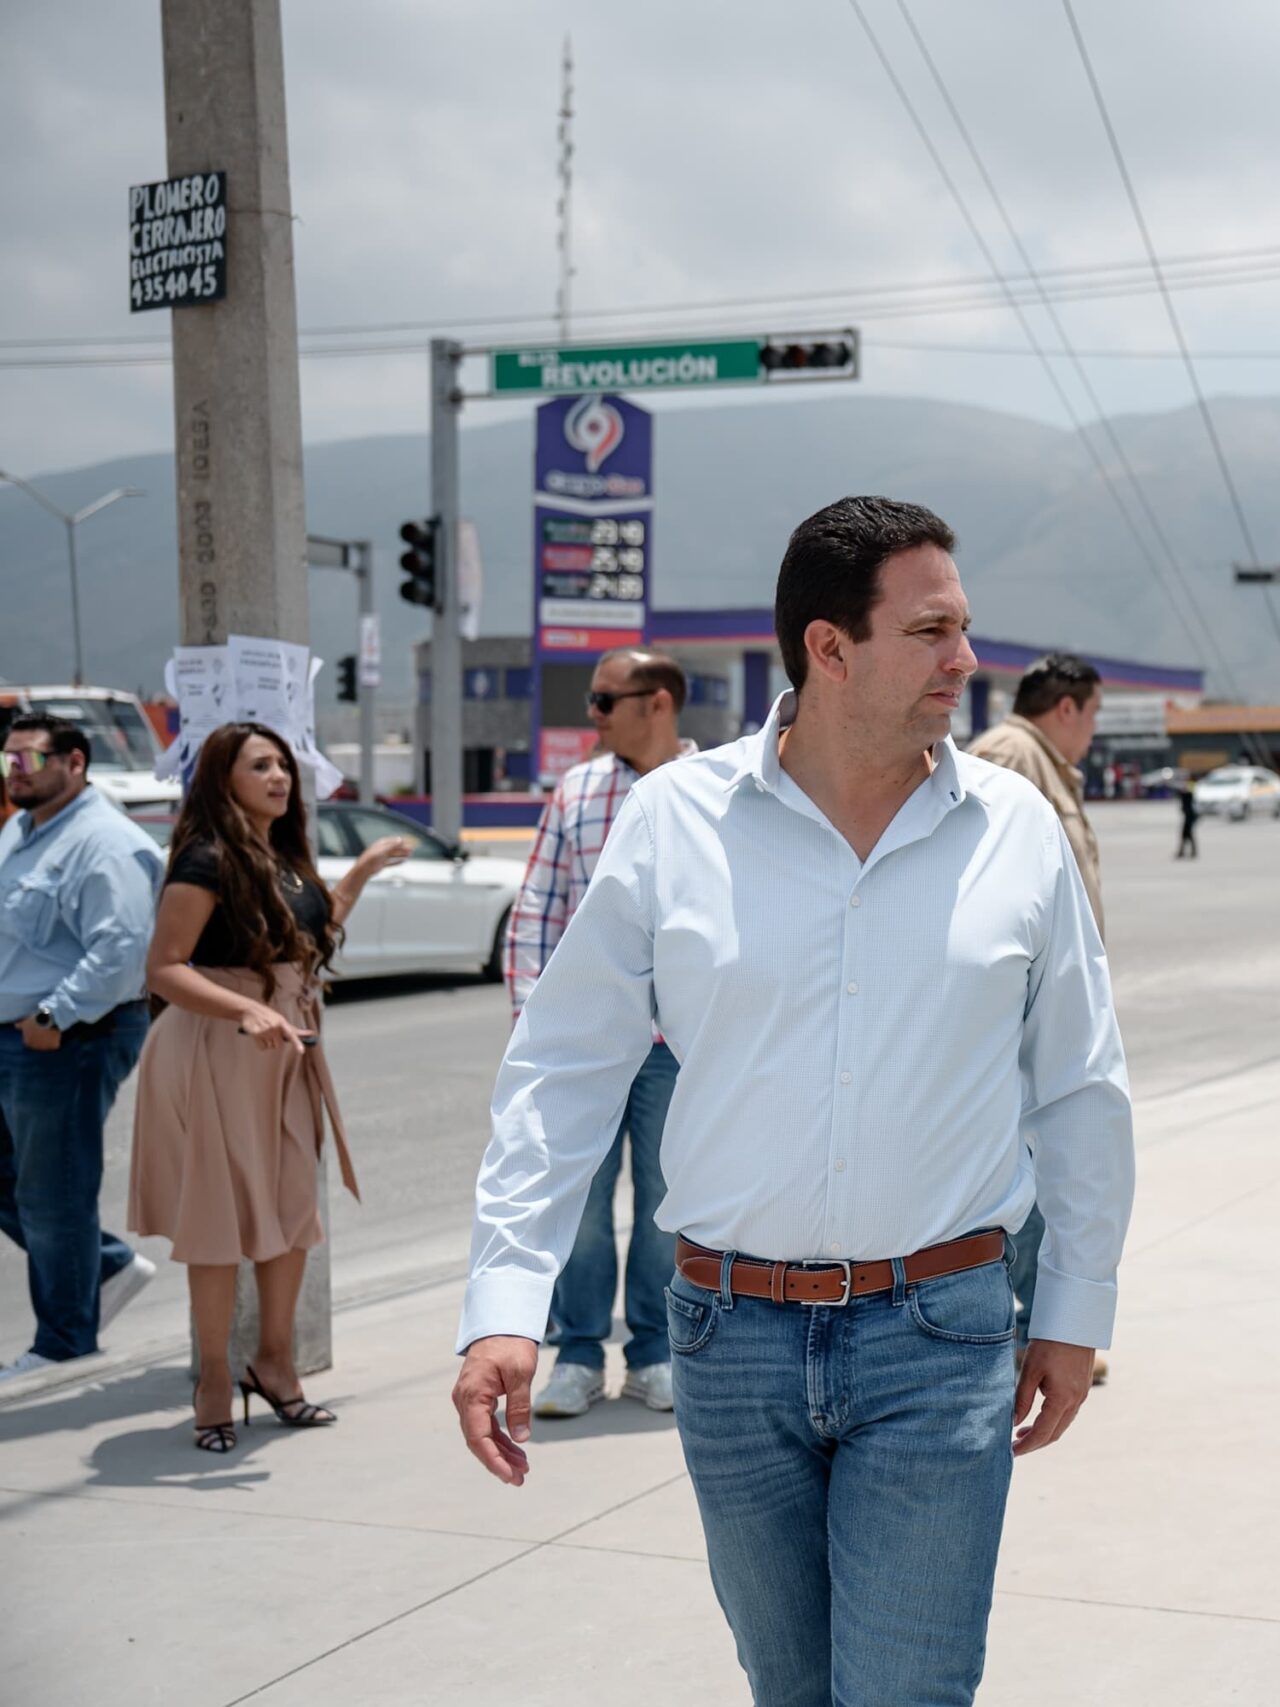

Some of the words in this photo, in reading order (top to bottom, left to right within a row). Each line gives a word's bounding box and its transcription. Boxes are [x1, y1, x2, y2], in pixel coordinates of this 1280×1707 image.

[130, 173, 220, 223] PLOMERO
[130, 203, 226, 257] CERRAJERO
[541, 352, 717, 387] REVOLUCIÓN
